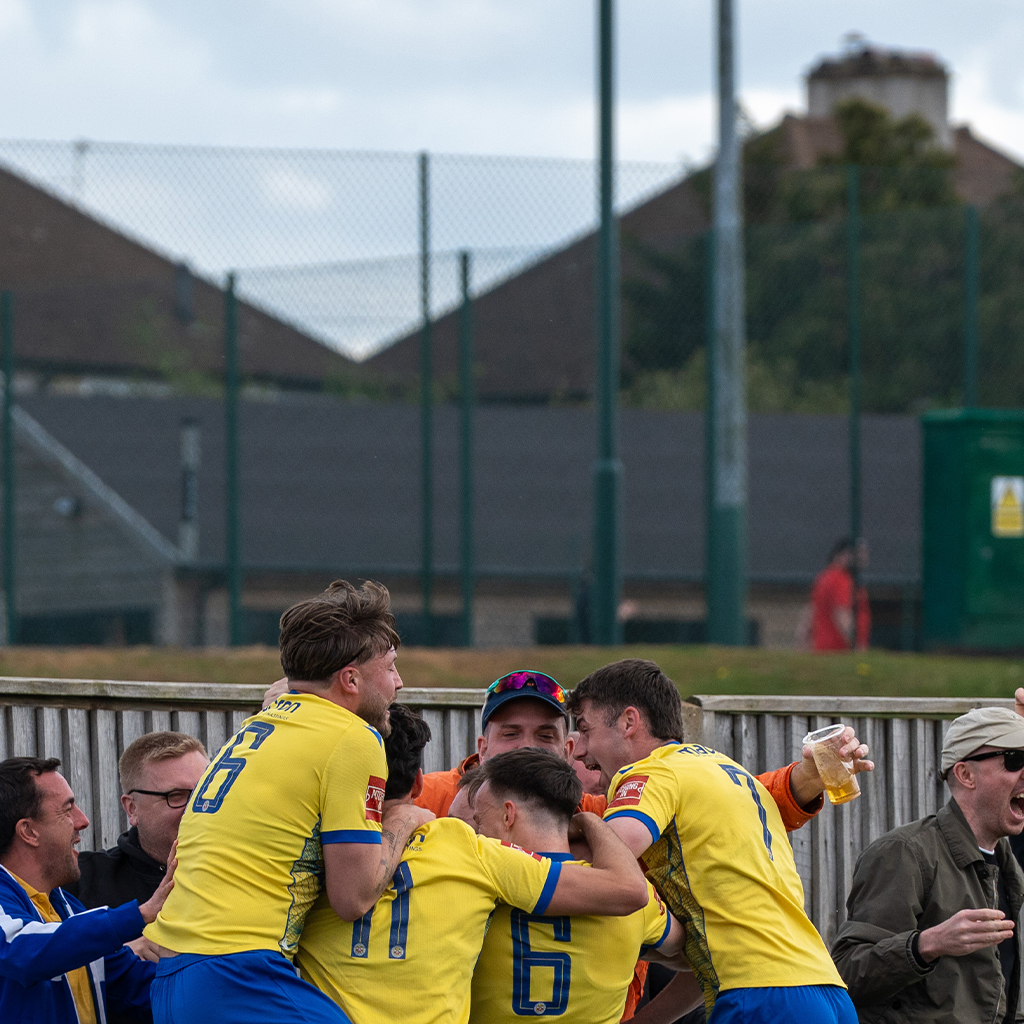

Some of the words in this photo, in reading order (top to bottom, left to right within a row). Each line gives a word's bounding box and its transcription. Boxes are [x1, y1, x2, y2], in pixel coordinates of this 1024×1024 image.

[717, 763, 774, 862] 7
[351, 861, 414, 959] 11
[511, 907, 571, 1016] 6
